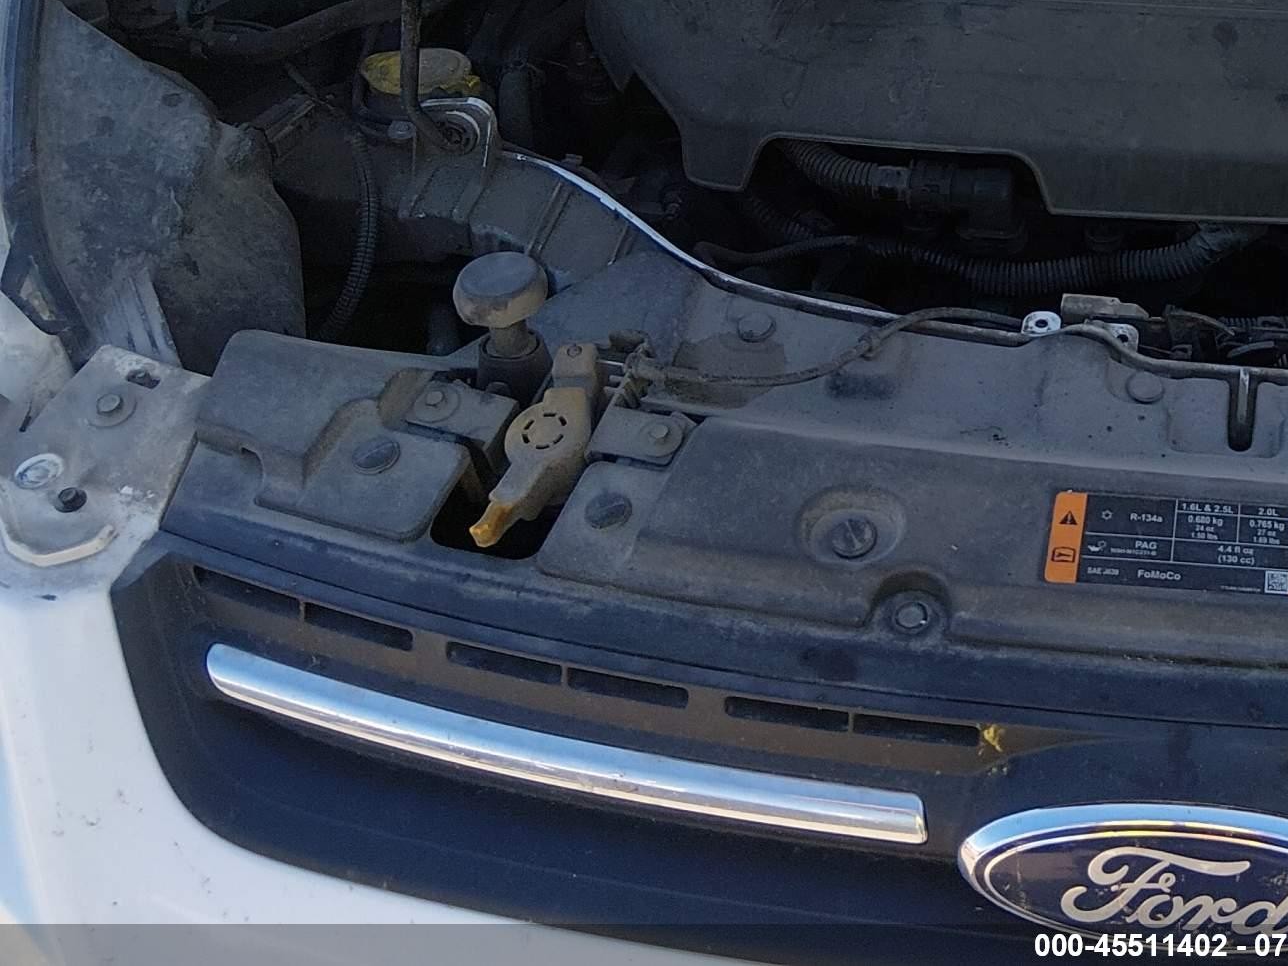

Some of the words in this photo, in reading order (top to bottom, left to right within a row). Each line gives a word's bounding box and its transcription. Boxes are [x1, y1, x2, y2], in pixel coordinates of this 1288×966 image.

[1182, 503, 1202, 511] 1.6L
[1203, 504, 1212, 512] &
[1214, 505, 1234, 513] 2.5L
[1258, 507, 1278, 516] 2.0L
[1130, 512, 1163, 523] R-134a
[1212, 517, 1223, 527] kg
[1249, 519, 1272, 528] 0.765
[1273, 521, 1285, 531] kg
[1135, 540, 1157, 550] PAG
[1218, 545, 1232, 553] 4.4
[1217, 554, 1238, 564] (130
[1239, 556, 1255, 565] cc)
[1137, 569, 1181, 581] FoMoCo
